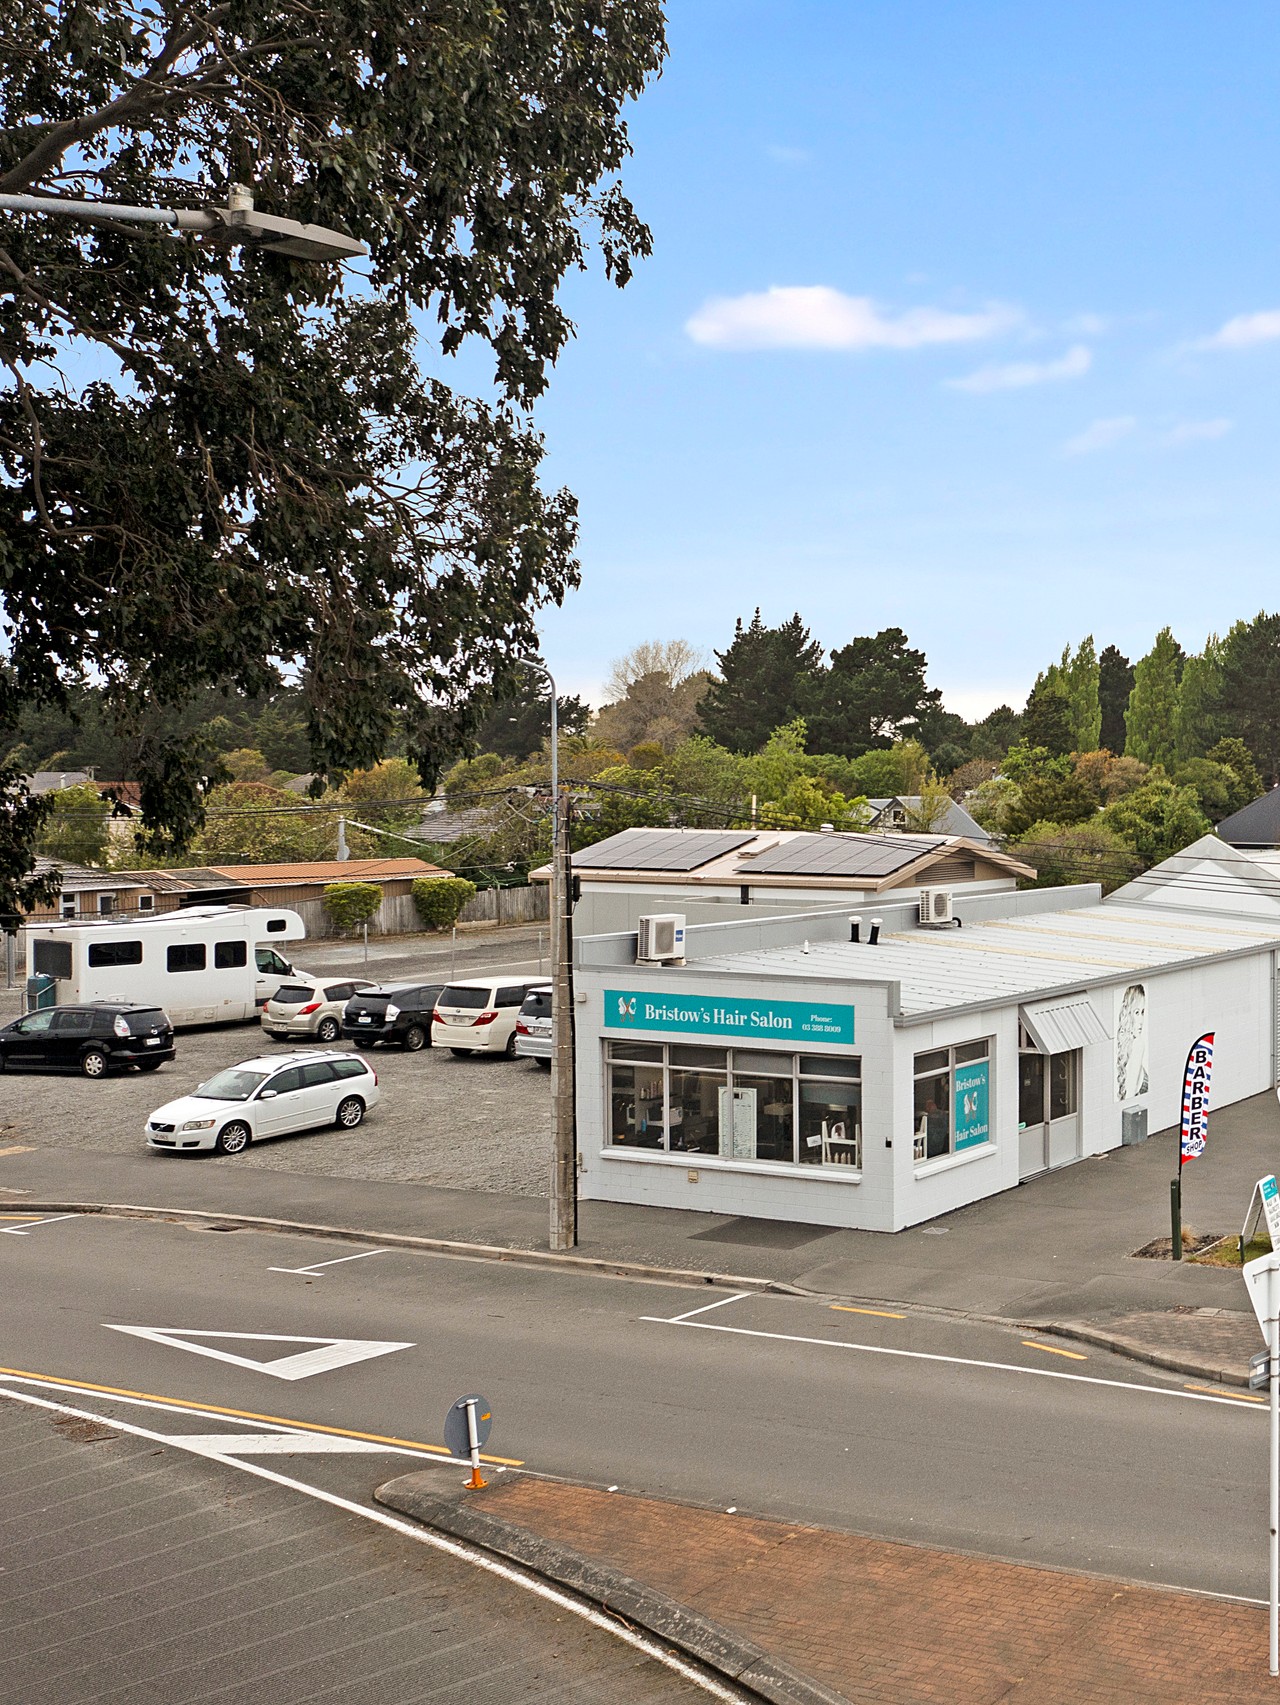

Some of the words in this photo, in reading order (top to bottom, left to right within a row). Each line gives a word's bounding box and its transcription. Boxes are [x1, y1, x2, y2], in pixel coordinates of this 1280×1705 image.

[644, 1003, 711, 1024] Bristow's
[712, 1008, 747, 1026] Hair
[750, 1011, 793, 1029] Salon
[810, 1014, 833, 1023] Phone:
[802, 1023, 811, 1031] 03
[956, 1073, 986, 1092] Bristow's
[1189, 1050, 1207, 1141] BARBER
[969, 1123, 988, 1138] Salon
[1186, 1140, 1202, 1154] SHOP
